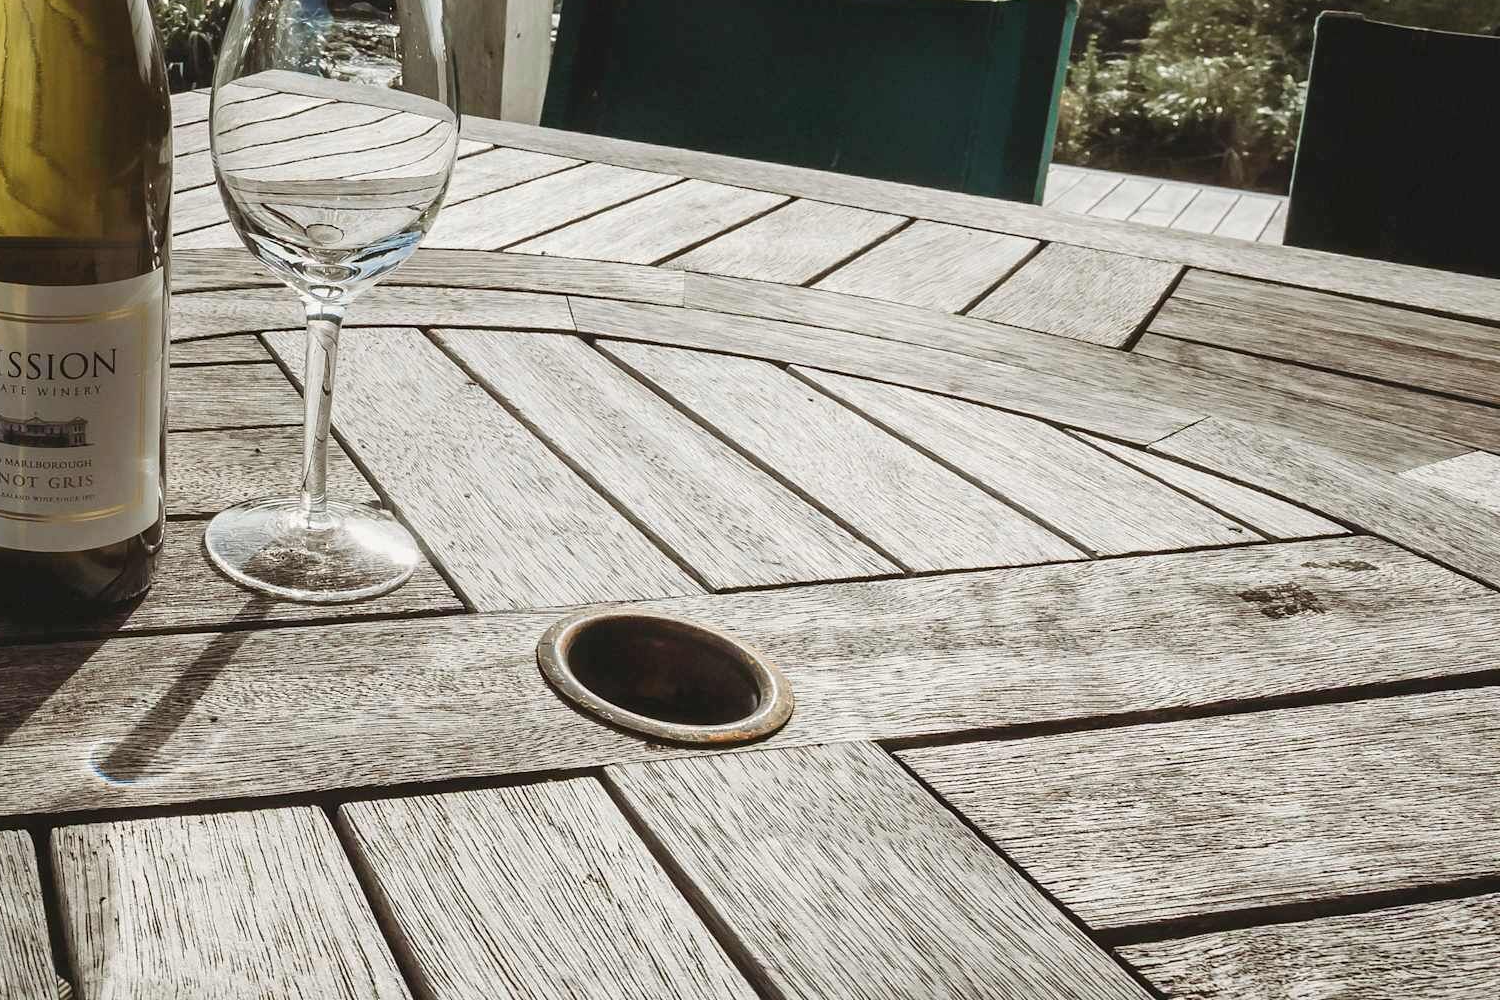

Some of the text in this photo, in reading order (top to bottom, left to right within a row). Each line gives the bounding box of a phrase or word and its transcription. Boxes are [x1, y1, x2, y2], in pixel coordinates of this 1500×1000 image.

[37, 383, 102, 397] WINERY
[4, 457, 93, 470] MARLBOROUGH
[48, 474, 93, 489] GRIS
